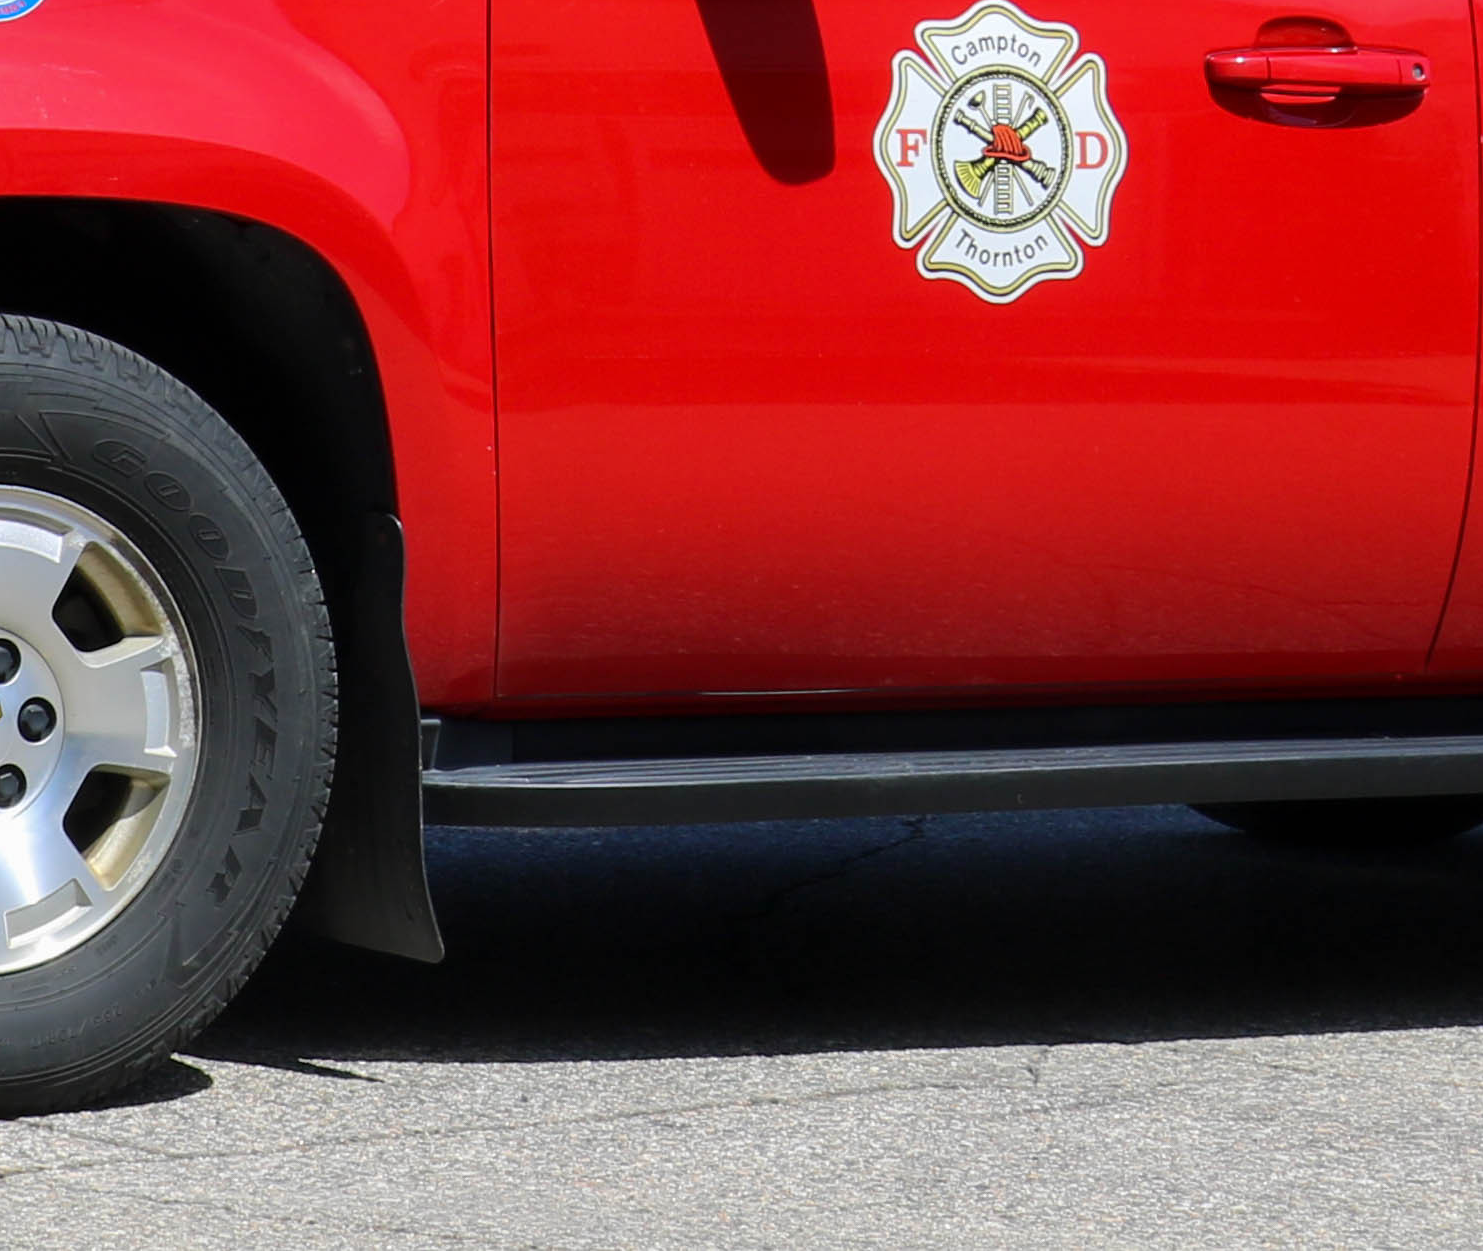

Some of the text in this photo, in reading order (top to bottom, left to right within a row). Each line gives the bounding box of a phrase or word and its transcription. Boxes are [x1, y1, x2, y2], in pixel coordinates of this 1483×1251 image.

[950, 33, 1042, 67] Campton
[895, 128, 1110, 170] F D
[955, 229, 1048, 266] Thornton
[91, 437, 280, 910] GOODYEAR
